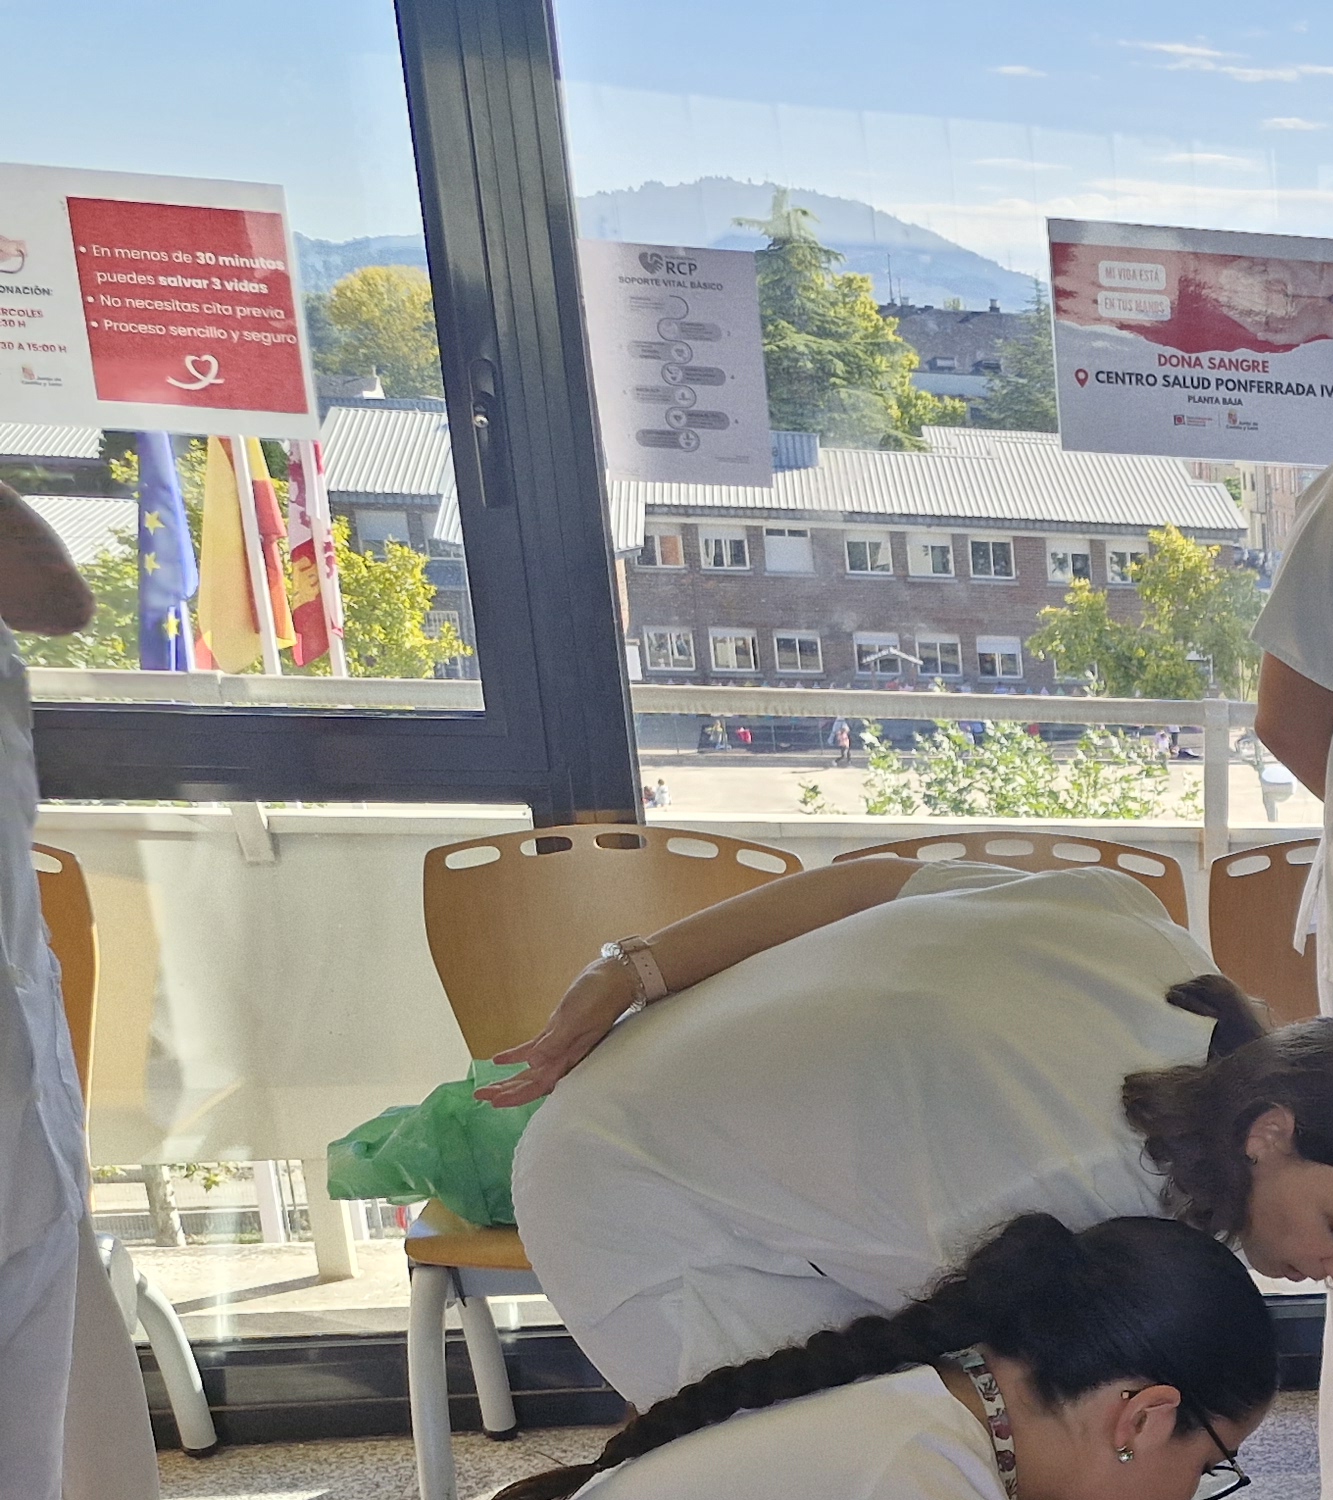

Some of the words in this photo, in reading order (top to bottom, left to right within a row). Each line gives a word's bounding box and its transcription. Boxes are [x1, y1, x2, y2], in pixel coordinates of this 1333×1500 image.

[92, 245, 111, 258] En
[115, 247, 169, 262] menos
[172, 249, 192, 263] de
[196, 252, 216, 266] 30
[219, 253, 285, 271] minutos
[665, 261, 698, 276] RCP
[1105, 267, 1116, 279] MI
[1117, 268, 1138, 281] VIDA
[1140, 268, 1160, 282] ESTÁ
[96, 271, 156, 286] puedes
[159, 275, 210, 289] salvar
[211, 277, 222, 290] 3
[224, 279, 269, 294] vidas
[618, 276, 661, 287] SOPORTE
[662, 279, 688, 289] VITAL
[100, 294, 121, 308] No
[125, 296, 200, 313] necesitas
[203, 302, 233, 316] cita
[236, 305, 285, 320] previa
[1105, 297, 1115, 310] EN
[1117, 298, 1133, 312] TUS
[18, 320, 26, 328] H
[104, 319, 166, 336] Proceso
[169, 324, 227, 340] sencillo
[231, 329, 240, 344] y
[244, 331, 298, 346] seguro
[18, 342, 25, 351] A
[26, 342, 56, 352] 15:00
[59, 345, 67, 353] H
[1157, 353, 1204, 369] DONA
[1208, 357, 1270, 373] SANGRE
[1095, 370, 1158, 387] CENTRO
[1162, 375, 1211, 390] SALUD
[1215, 378, 1316, 397] PONFERRADA
[1187, 395, 1220, 405] PLANTA
[1222, 396, 1243, 407] BAJA
